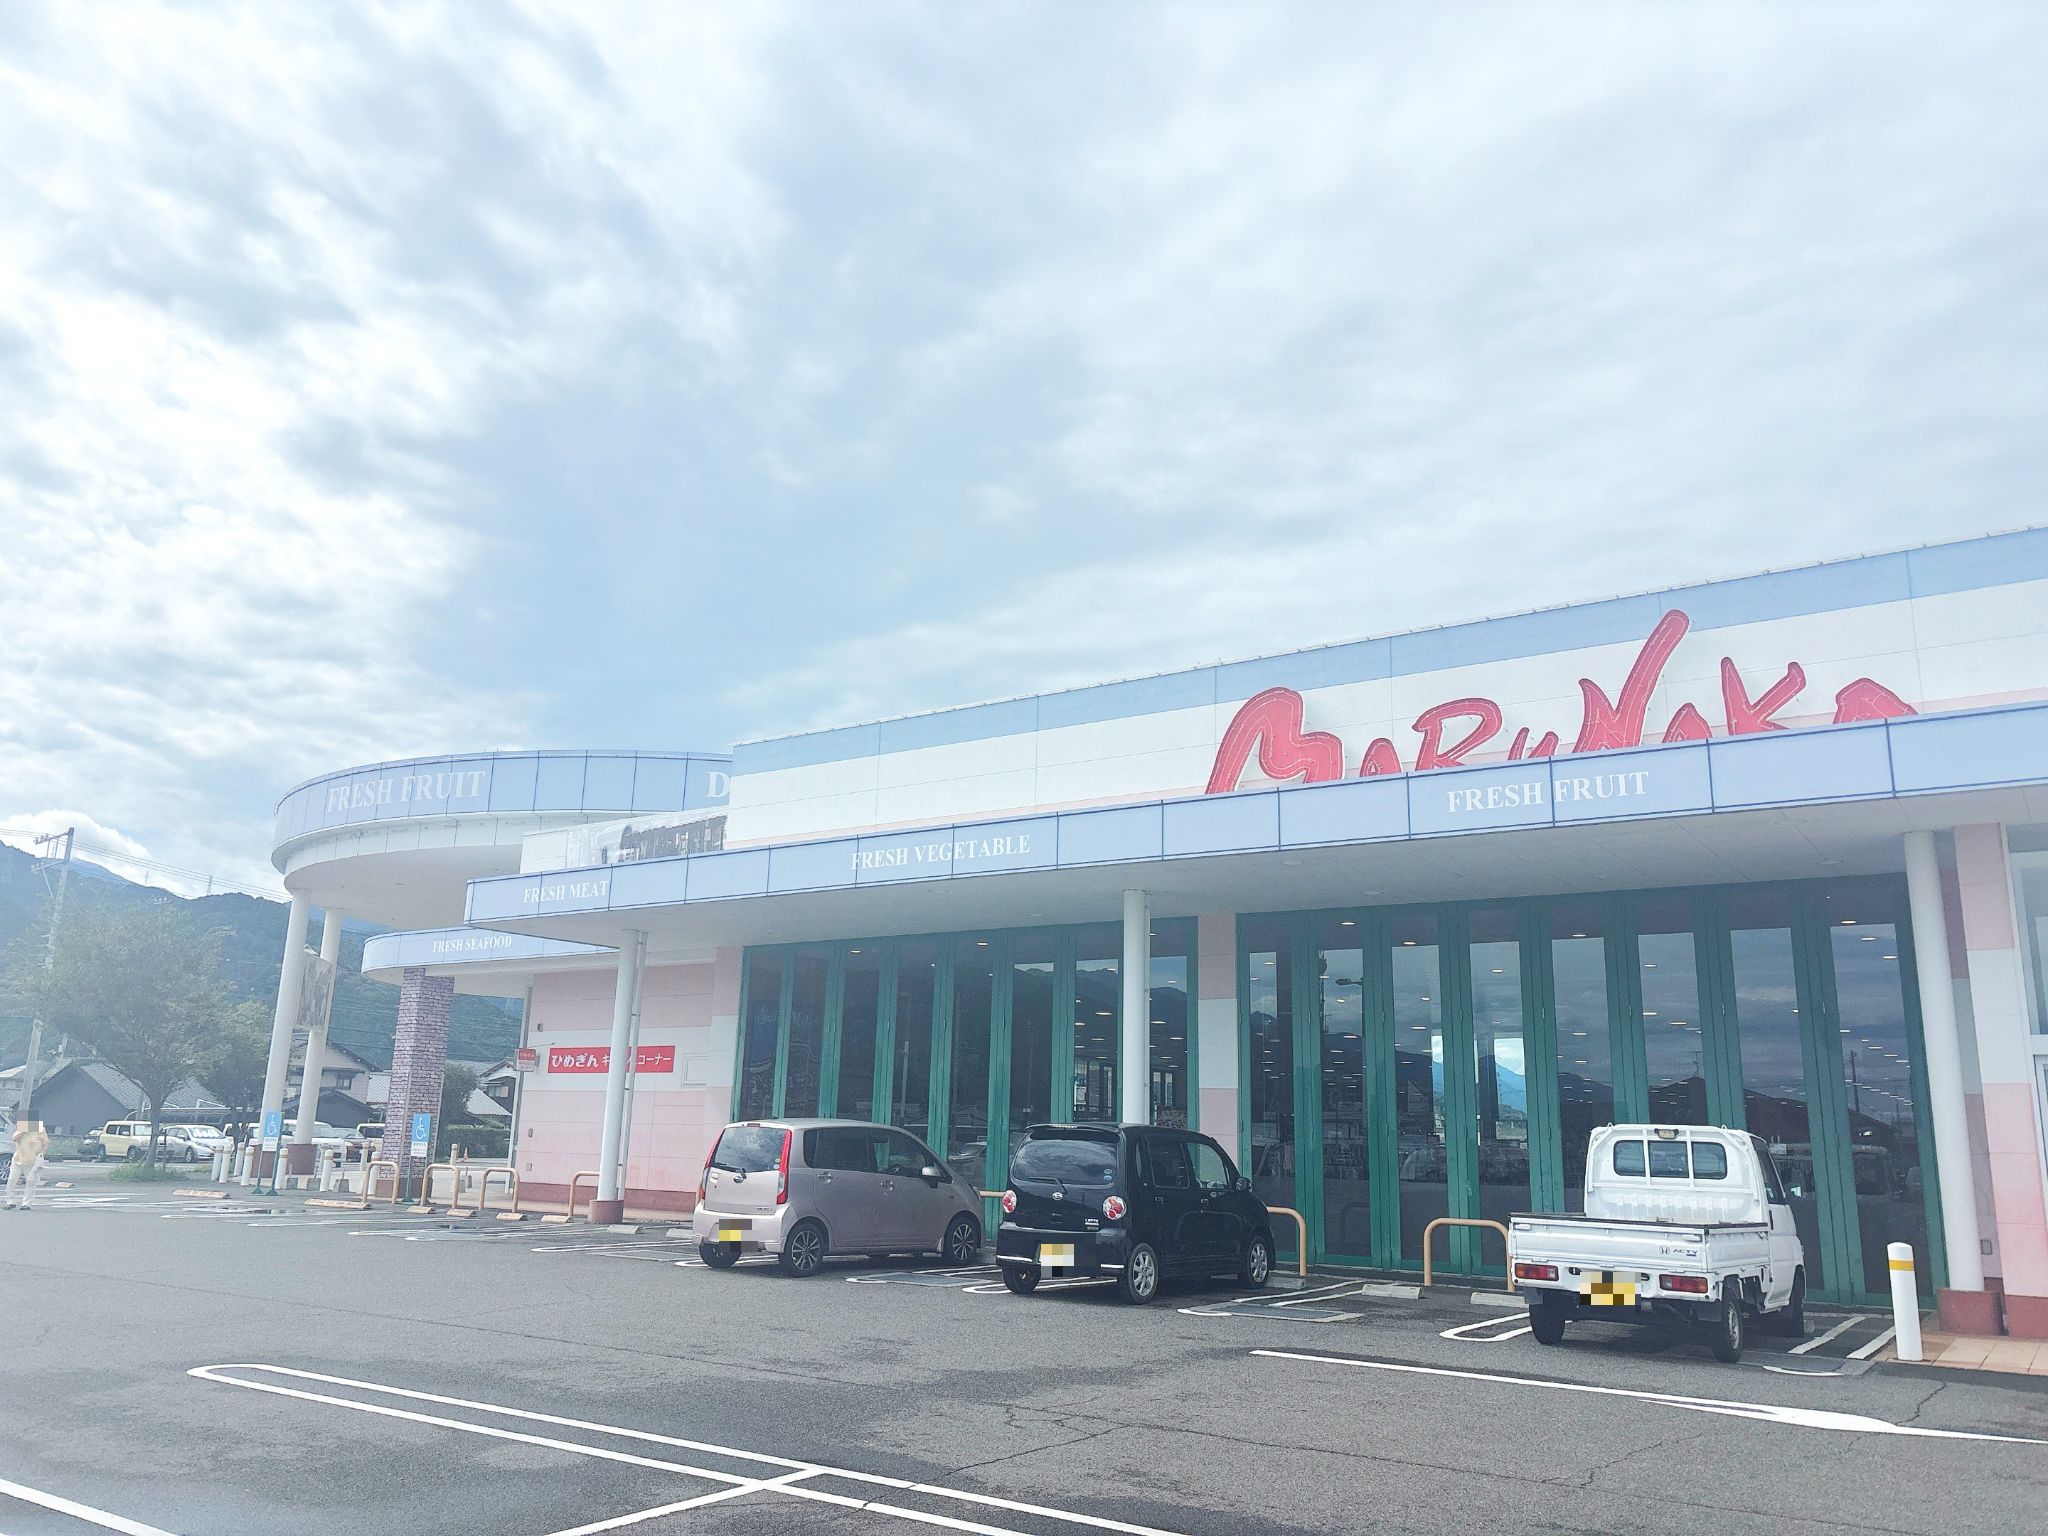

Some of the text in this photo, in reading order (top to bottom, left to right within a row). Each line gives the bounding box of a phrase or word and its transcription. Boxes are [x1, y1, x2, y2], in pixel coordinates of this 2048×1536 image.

[327, 770, 487, 813] FRESH FRUIT
[1446, 771, 1649, 813] FRESH FRUIT
[850, 834, 1031, 870] FRESH VEGETABLE
[523, 880, 609, 904] FRESH MEAT
[432, 935, 513, 953] FRESH SEAFOOD
